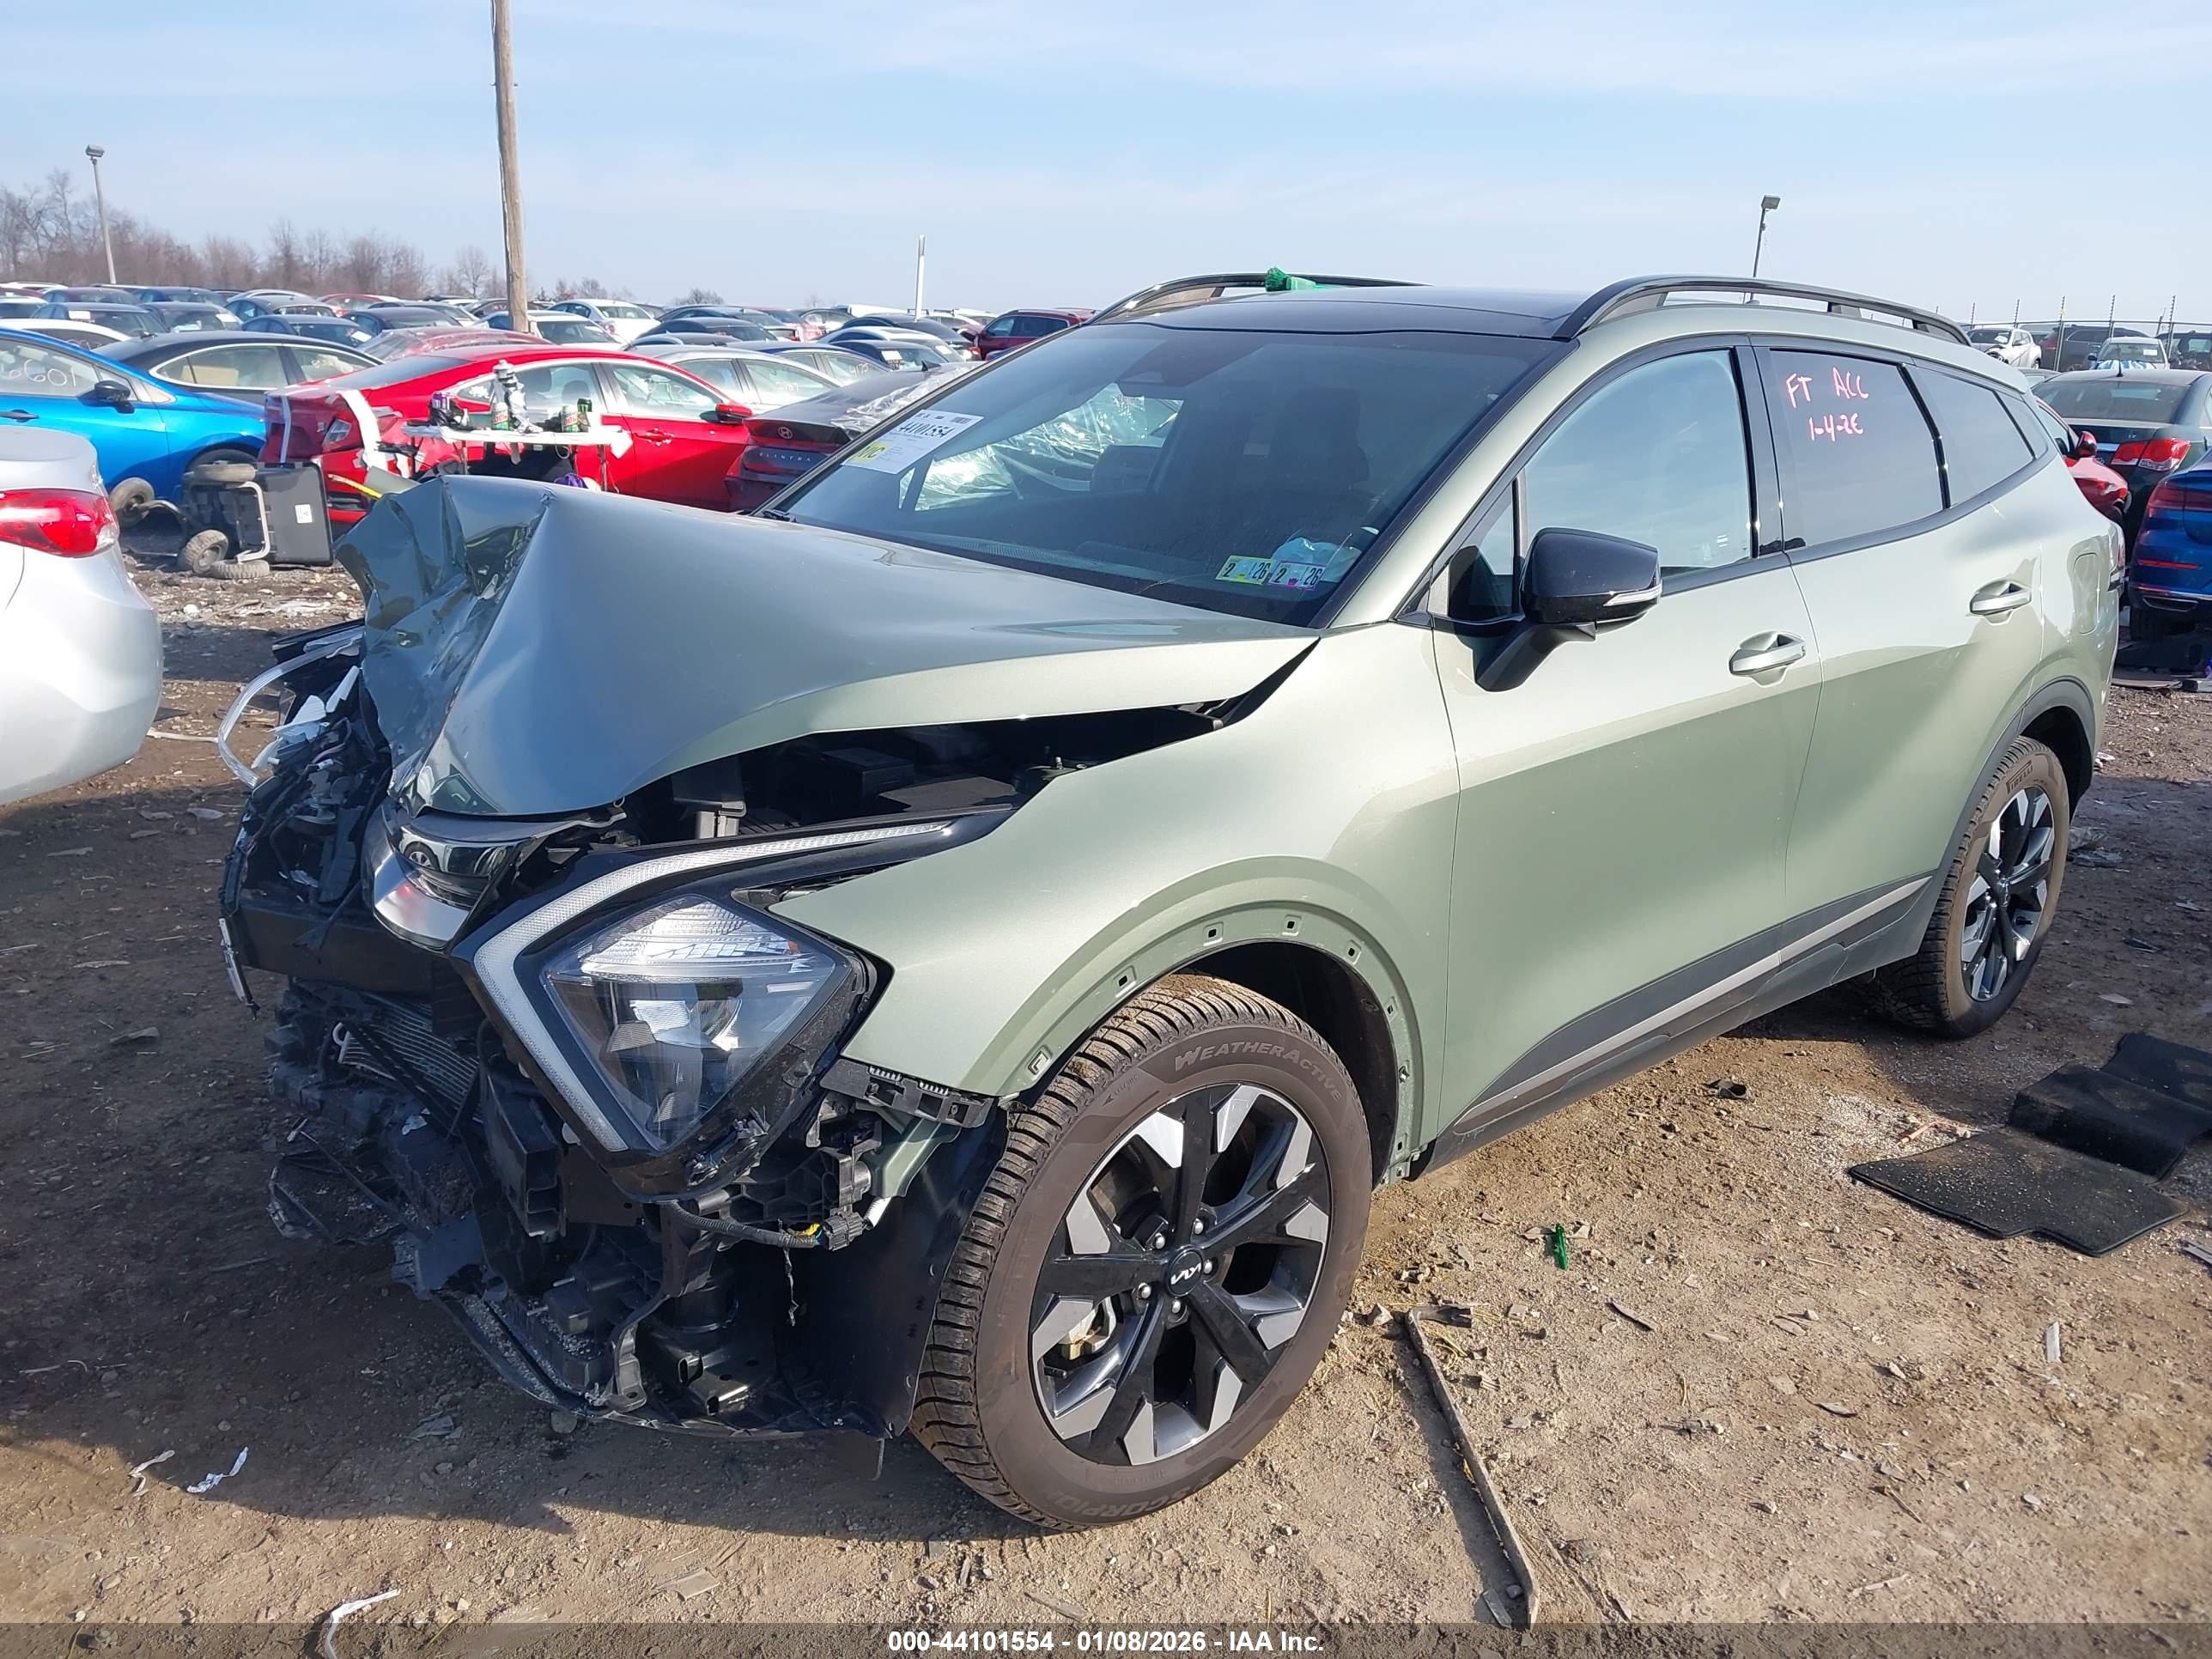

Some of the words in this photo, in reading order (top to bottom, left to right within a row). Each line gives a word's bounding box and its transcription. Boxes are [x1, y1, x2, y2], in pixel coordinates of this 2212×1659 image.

[1786, 373, 1813, 409] FT
[1223, 562, 1237, 577] 2
[1251, 562, 1271, 580] 26
[1273, 568, 1288, 583] 2
[1304, 567, 1323, 586] 26
[2006, 759, 2033, 795] PIRELLI
